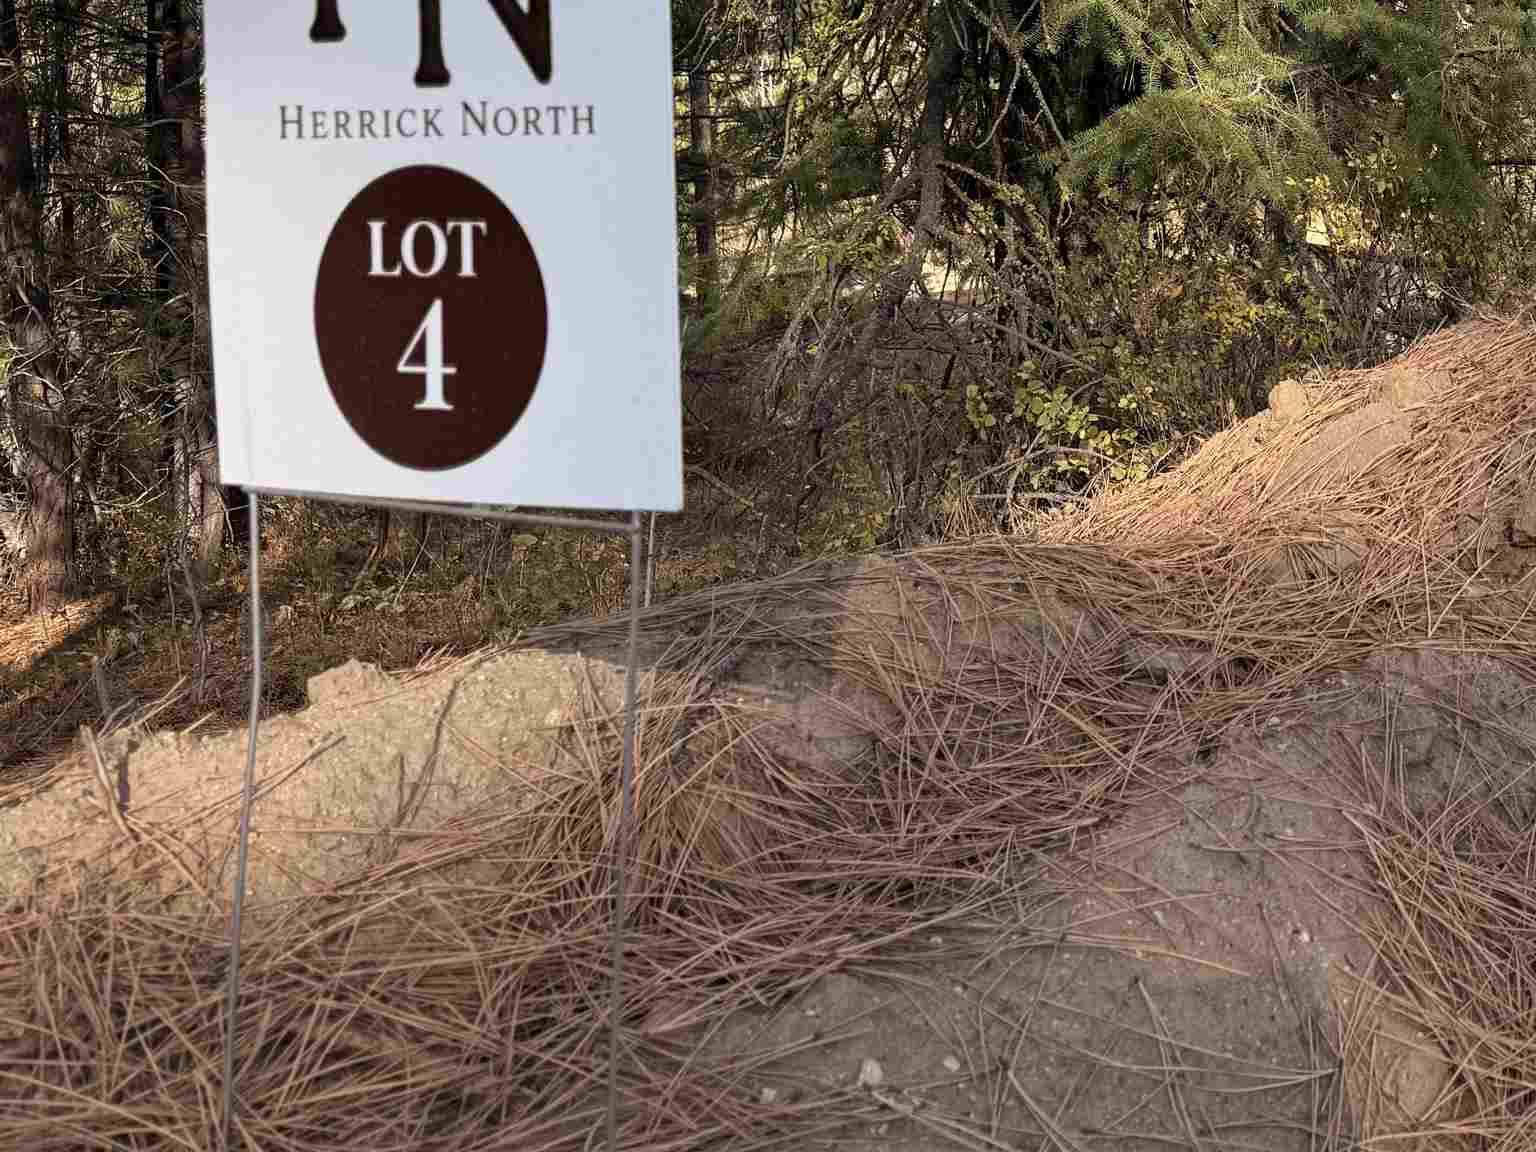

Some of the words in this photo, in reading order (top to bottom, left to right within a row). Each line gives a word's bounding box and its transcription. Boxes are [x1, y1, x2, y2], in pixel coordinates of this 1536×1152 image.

[279, 104, 444, 140] HERRICK
[461, 100, 596, 137] NORTH
[367, 220, 487, 278] LOT
[396, 297, 457, 412] 4
